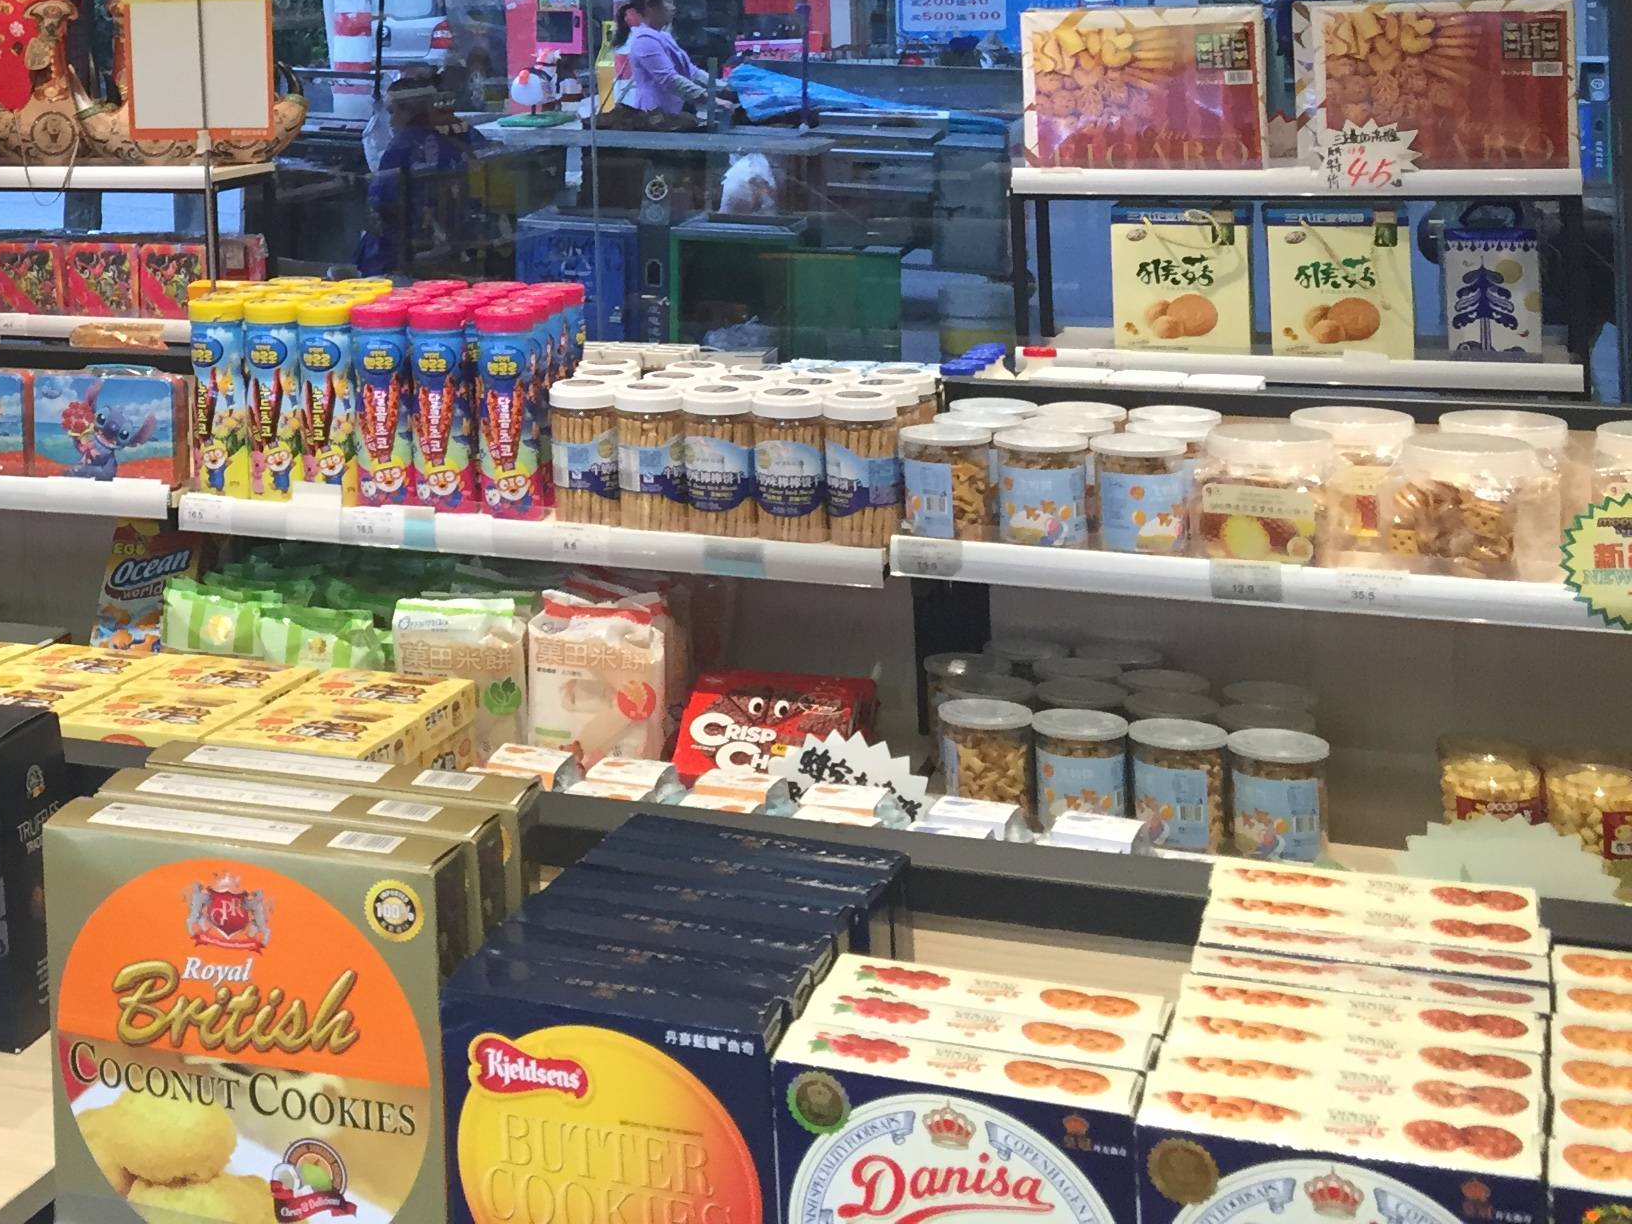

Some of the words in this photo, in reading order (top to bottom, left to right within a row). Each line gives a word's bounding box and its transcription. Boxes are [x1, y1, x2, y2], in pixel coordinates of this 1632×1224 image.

[115, 549, 190, 584] Ocean
[1232, 584, 1255, 594] 12.9
[1351, 590, 1375, 601] 35.5
[689, 712, 777, 746] CRISP
[182, 956, 252, 987] Royal
[112, 960, 359, 1053] British
[70, 1041, 240, 1110] COCONUT
[249, 1073, 416, 1136] COOKIES
[487, 1047, 580, 1090] Kjeldsens
[502, 1112, 715, 1199] BUTTER
[1004, 1132, 1084, 1206] COPENHAGEN
[838, 1153, 1054, 1217] Danisa
